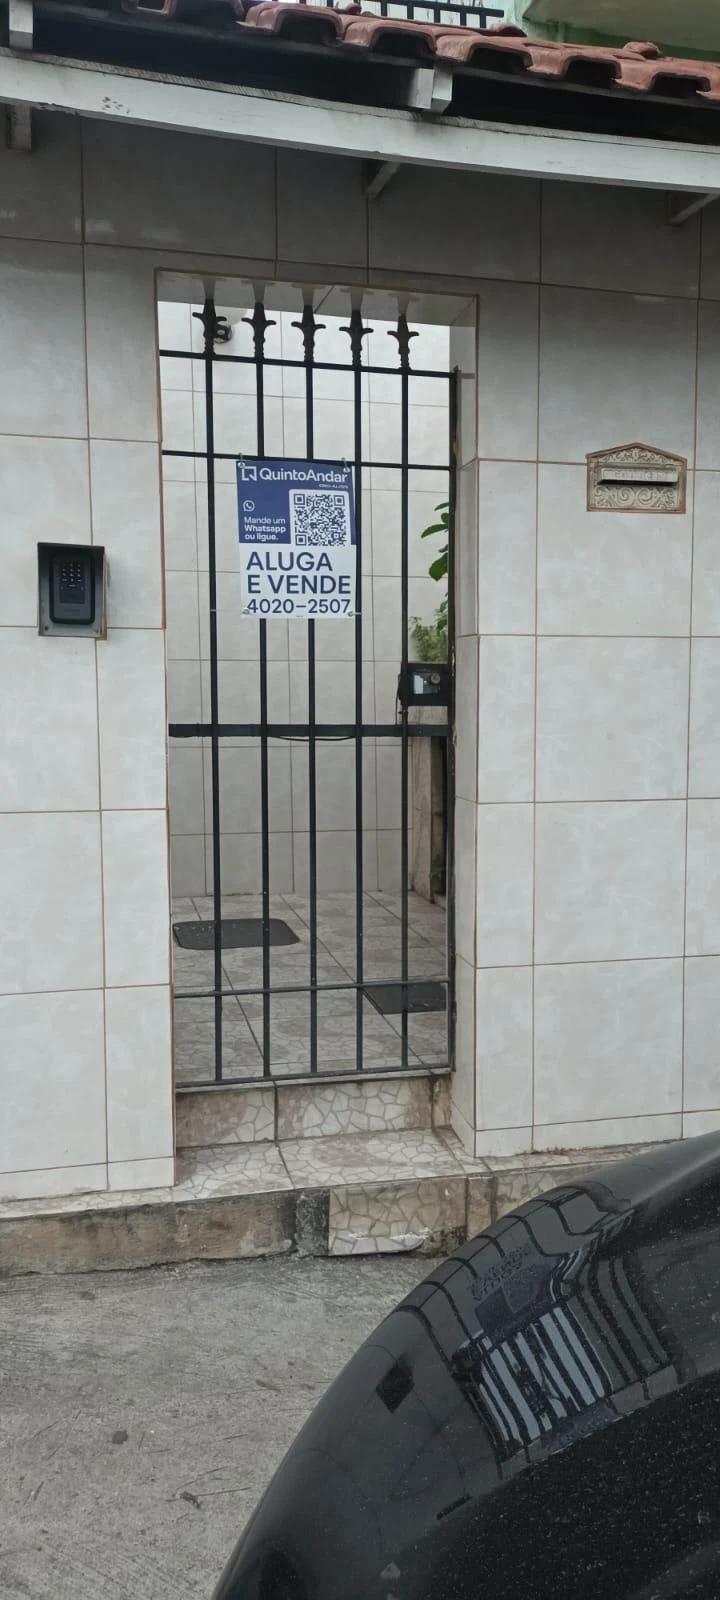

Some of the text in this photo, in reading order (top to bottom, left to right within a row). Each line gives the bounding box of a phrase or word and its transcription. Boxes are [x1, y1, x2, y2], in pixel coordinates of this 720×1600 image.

[259, 467, 348, 483] QuintoAndar
[244, 517, 270, 525] Mande
[244, 526, 286, 534] Whatsapp
[257, 533, 279, 542] ligue.
[246, 551, 333, 571] ALUGA
[247, 575, 351, 594] E VENDE
[247, 599, 351, 614] 4020-2507
